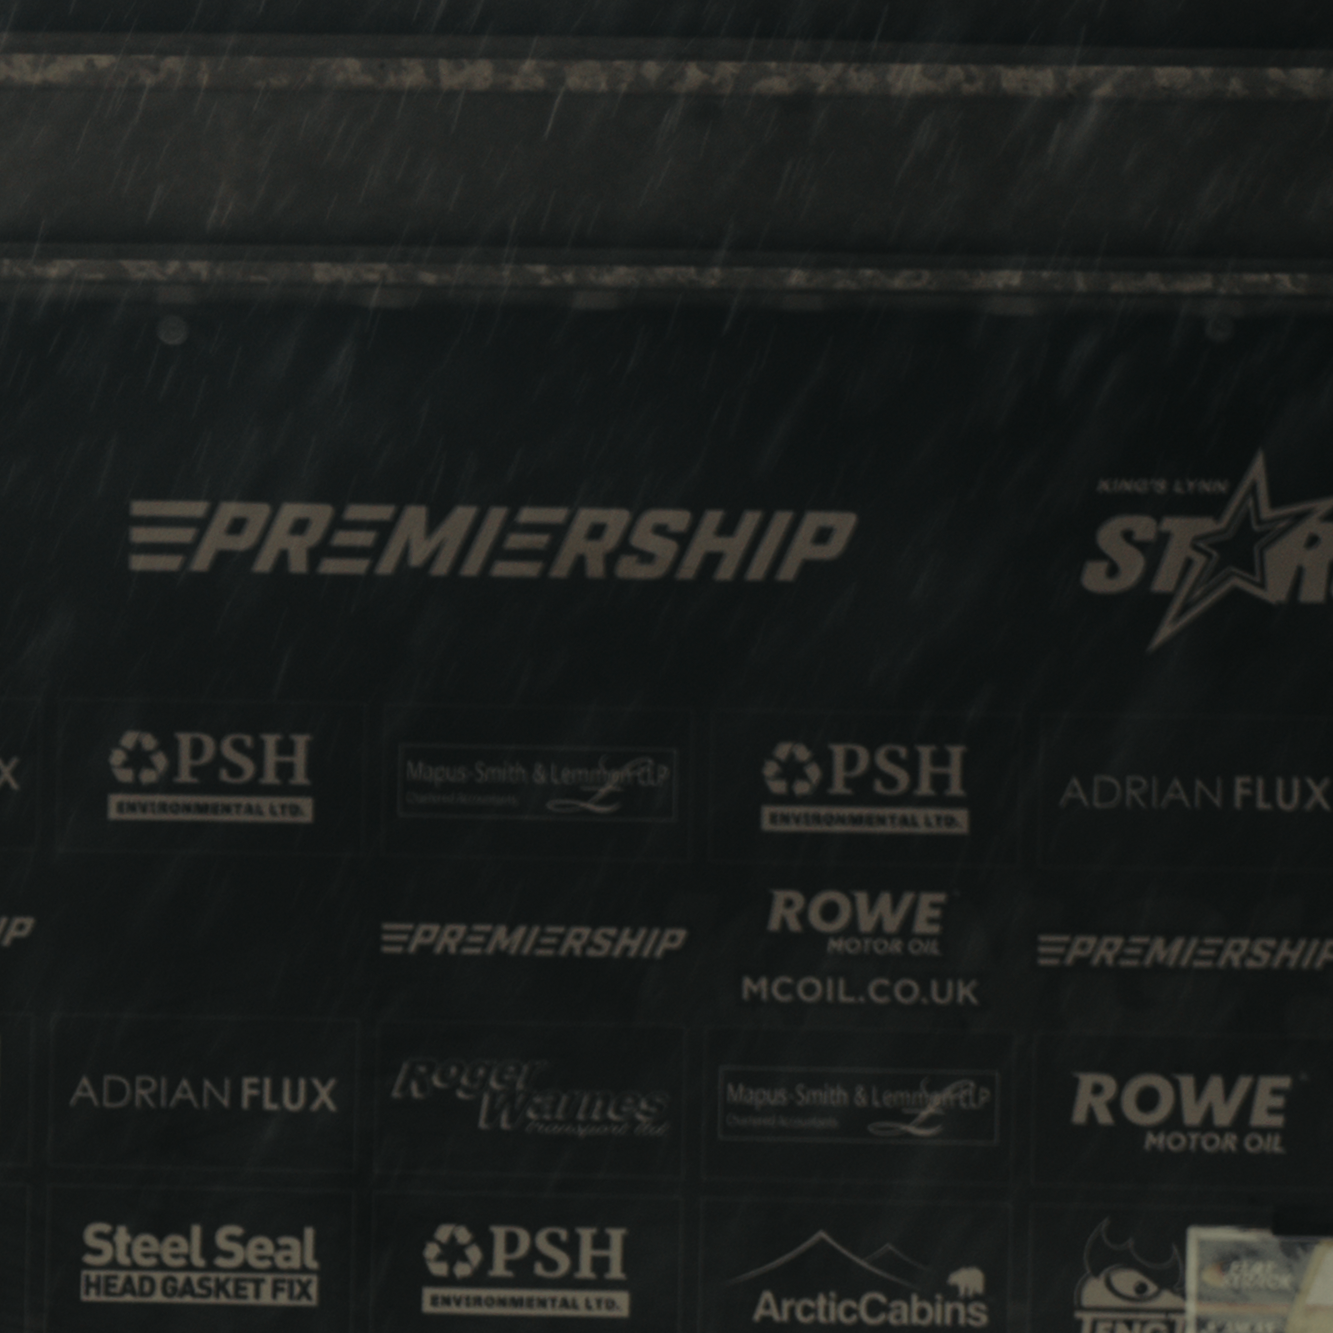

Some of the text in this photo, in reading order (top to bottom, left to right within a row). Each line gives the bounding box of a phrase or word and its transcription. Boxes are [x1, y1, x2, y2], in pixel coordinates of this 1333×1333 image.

[1174, 478, 1229, 494] LYNN
[189, 501, 857, 582] PREMIERSHIP
[174, 732, 312, 786] PSH
[532, 763, 546, 785] &
[828, 744, 968, 796] PSH
[1058, 775, 1332, 812] ADRIAN FLUX
[768, 890, 947, 937] ROWE
[408, 923, 687, 960] PREMIERSHIP
[827, 937, 942, 957] MOTOR OIL
[1065, 934, 1333, 971] PREMIERSHIP
[741, 976, 980, 1006] MCOIL.CO.UK
[69, 1074, 337, 1112] ADRIAN FLUX
[853, 1085, 866, 1107] &
[1071, 1072, 1293, 1128] ROWE
[1143, 1131, 1286, 1155] MOTOR OIL
[81, 1222, 319, 1271] Steel Seal
[488, 1225, 627, 1280] PSH
[83, 1275, 313, 1303] HEAD GASKET FIX
[752, 1289, 989, 1328] ArcticCabins
